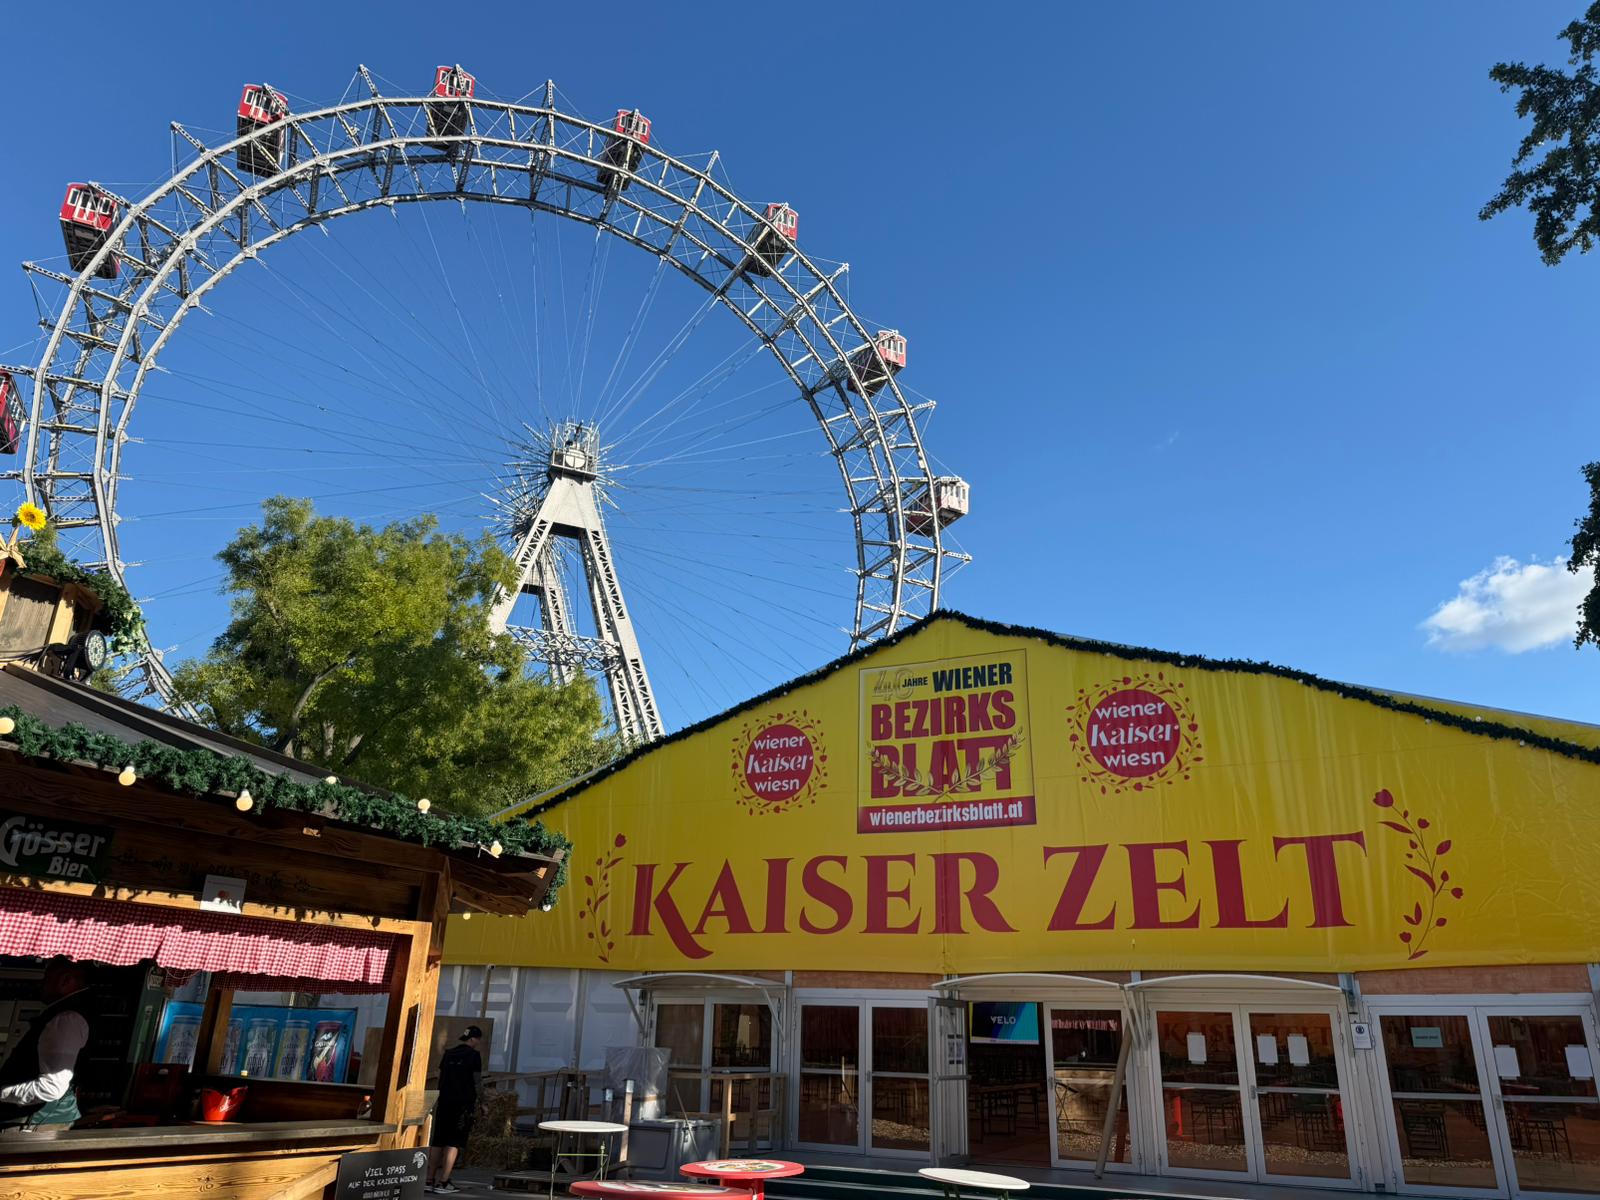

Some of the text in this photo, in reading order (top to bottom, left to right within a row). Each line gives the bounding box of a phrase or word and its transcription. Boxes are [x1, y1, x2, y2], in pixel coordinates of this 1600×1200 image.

[902, 676, 928, 688] JAHRE
[932, 662, 1012, 693] WIENER
[871, 689, 1016, 741] BEZIRKS
[1095, 701, 1166, 720] wiener
[753, 734, 806, 750] wiener
[871, 734, 1013, 799] BLATT
[1103, 749, 1165, 768] wiesn
[754, 776, 800, 793] wiesn
[869, 800, 1023, 827] wienerbezirksblatt.at
[0, 815, 106, 867] Gösser
[46, 856, 89, 878] Bier
[625, 830, 1368, 960] KAISER ZELT
[990, 1015, 1016, 1025] VELO
[365, 1165, 407, 1178] VIEL SPASS
